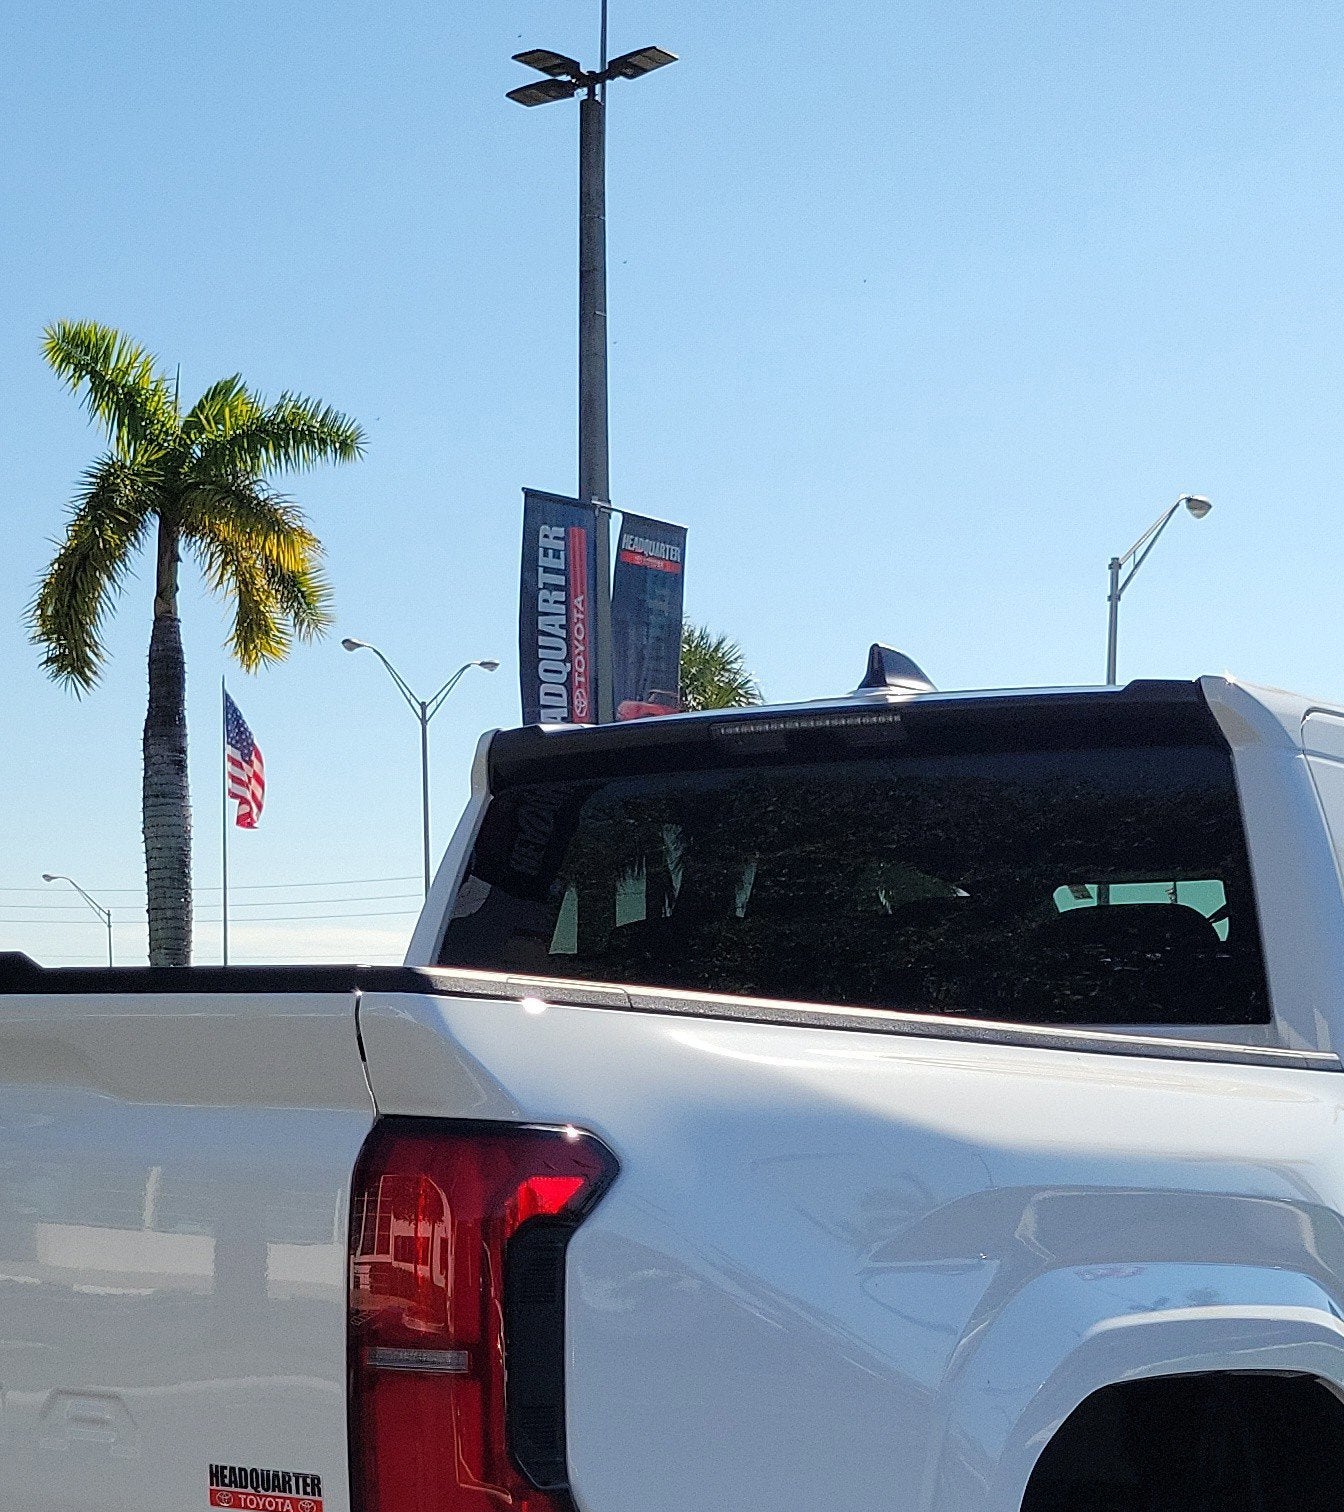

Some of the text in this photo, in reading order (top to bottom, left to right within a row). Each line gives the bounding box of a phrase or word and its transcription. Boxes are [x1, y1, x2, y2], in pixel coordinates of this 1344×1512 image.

[622, 533, 681, 562] HEADQUARTER
[538, 524, 571, 724] ADQUARTER
[571, 595, 586, 686] TOYOTA
[209, 1463, 322, 1498] HEADQUARTER
[238, 1494, 294, 1512] TOYOTA
